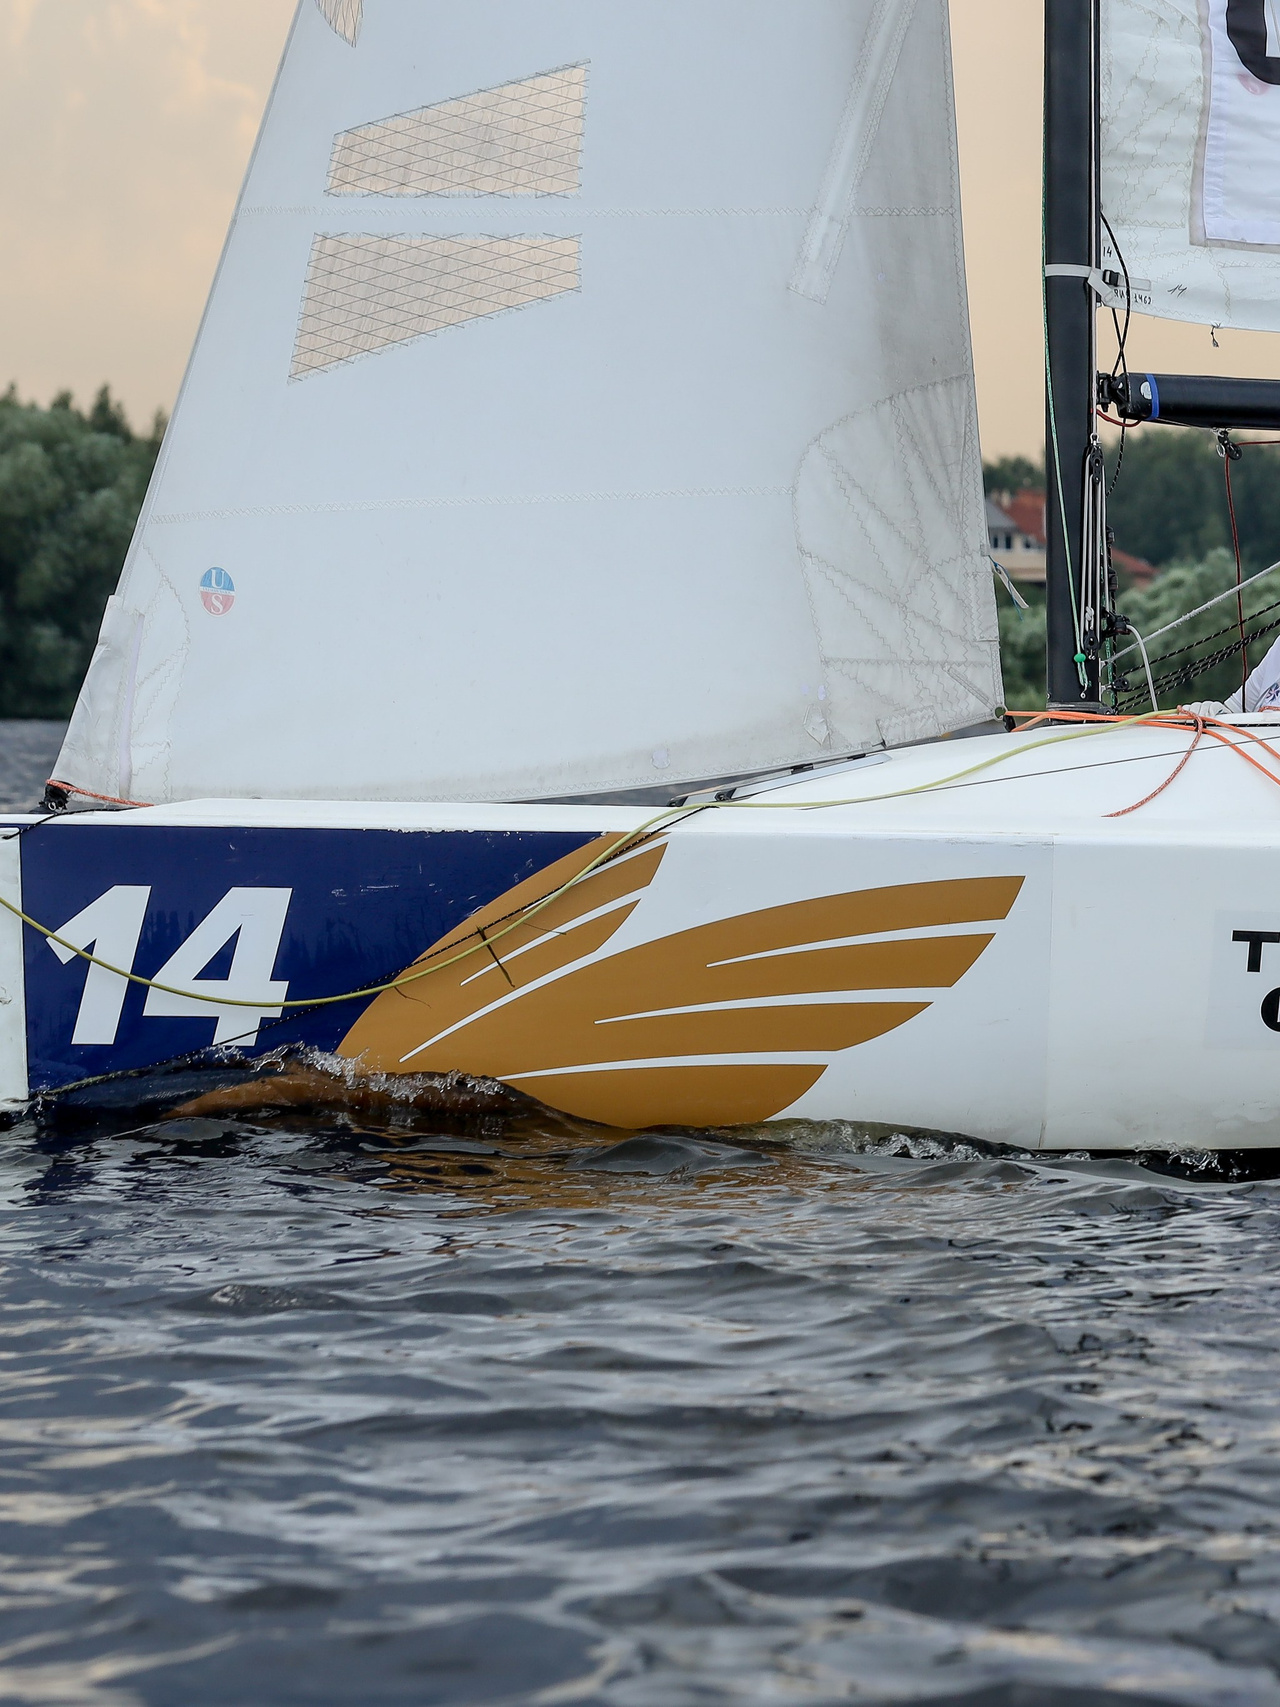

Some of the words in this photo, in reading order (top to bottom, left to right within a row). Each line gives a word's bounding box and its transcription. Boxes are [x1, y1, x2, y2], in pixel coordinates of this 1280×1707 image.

[1102, 246, 1113, 258] 14
[1167, 284, 1188, 299] 14
[45, 884, 293, 1047] 14
